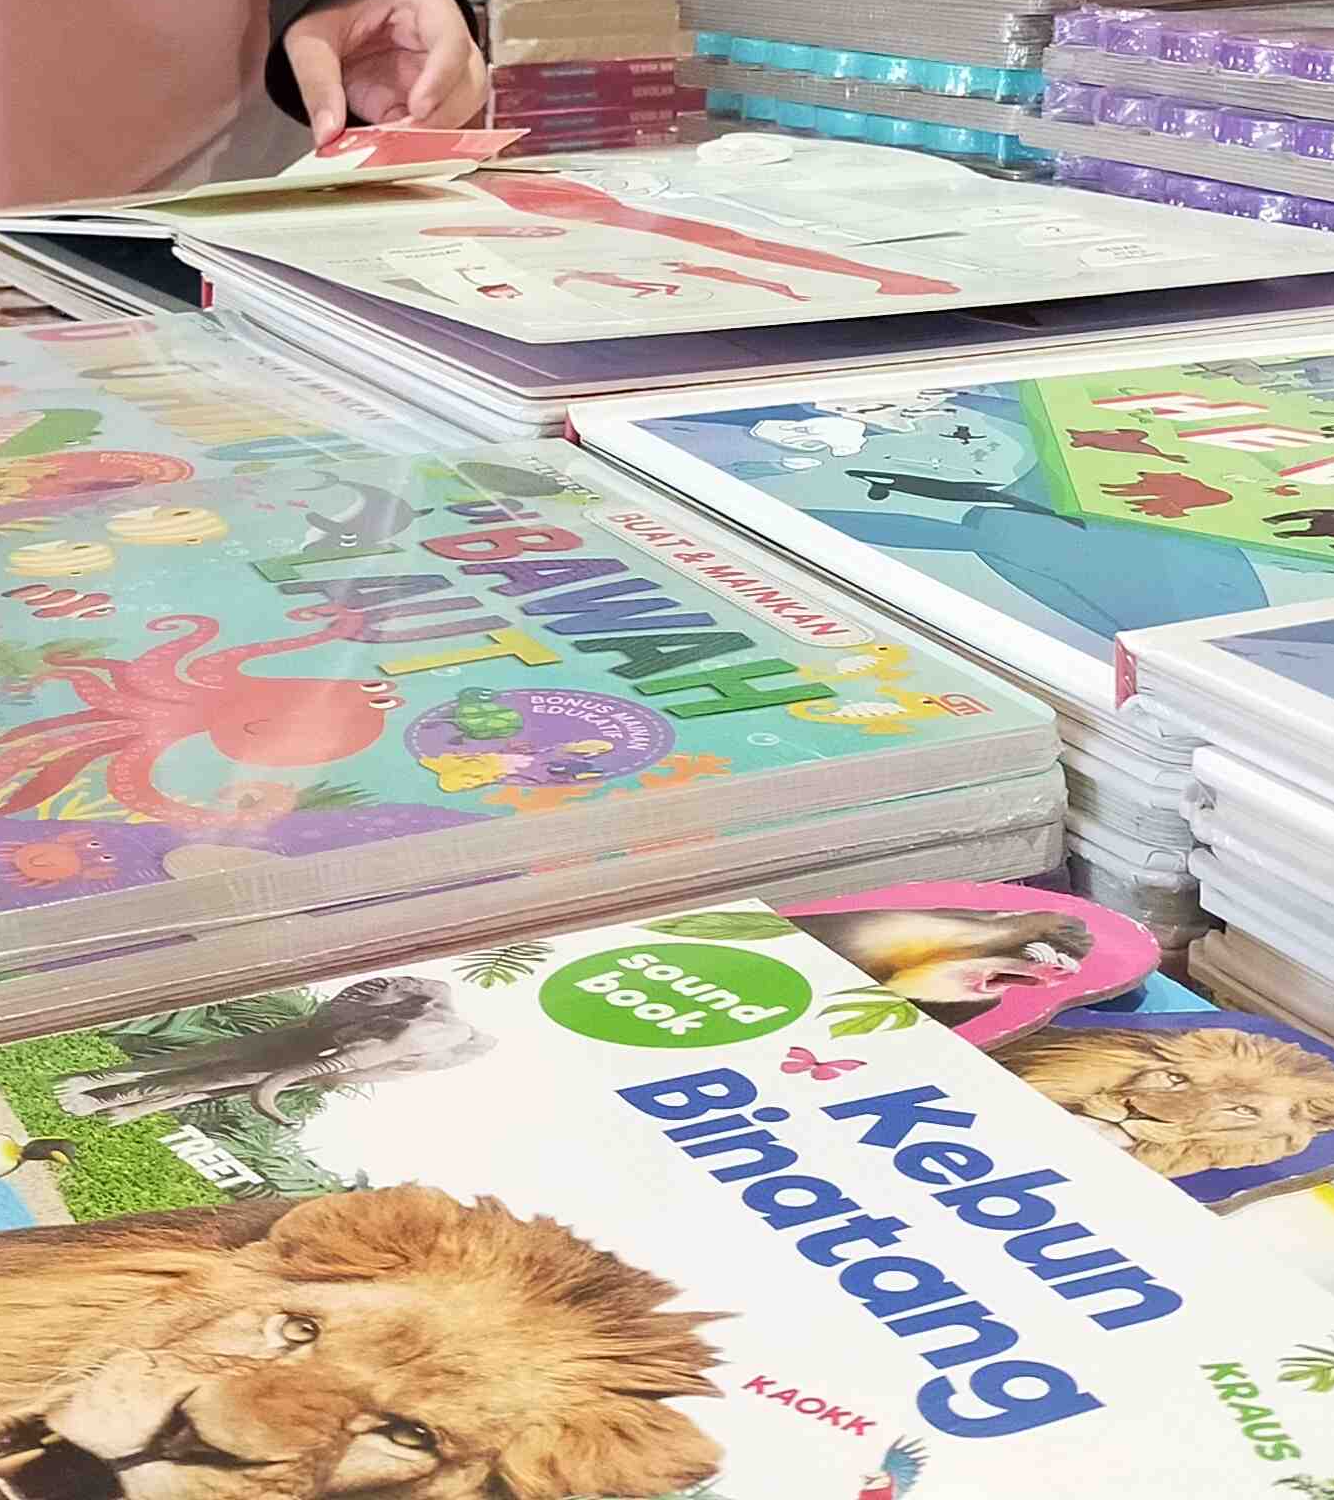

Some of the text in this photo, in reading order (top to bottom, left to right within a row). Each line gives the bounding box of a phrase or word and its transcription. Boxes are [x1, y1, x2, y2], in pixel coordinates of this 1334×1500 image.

[249, 540, 564, 677] LAUT
[607, 511, 851, 637] BUAT & MAINKAN
[419, 525, 838, 719] BAWAH
[530, 695, 615, 715] BONUS
[531, 704, 624, 740] EDUKATIF
[572, 970, 708, 1035] book
[616, 952, 790, 1025] sound
[157, 1123, 267, 1189] TREET
[820, 1083, 1184, 1332] Kebun
[614, 1066, 1106, 1440] Binatang
[740, 1373, 877, 1438] KAOKK
[1199, 1361, 1303, 1463] KRAUS
